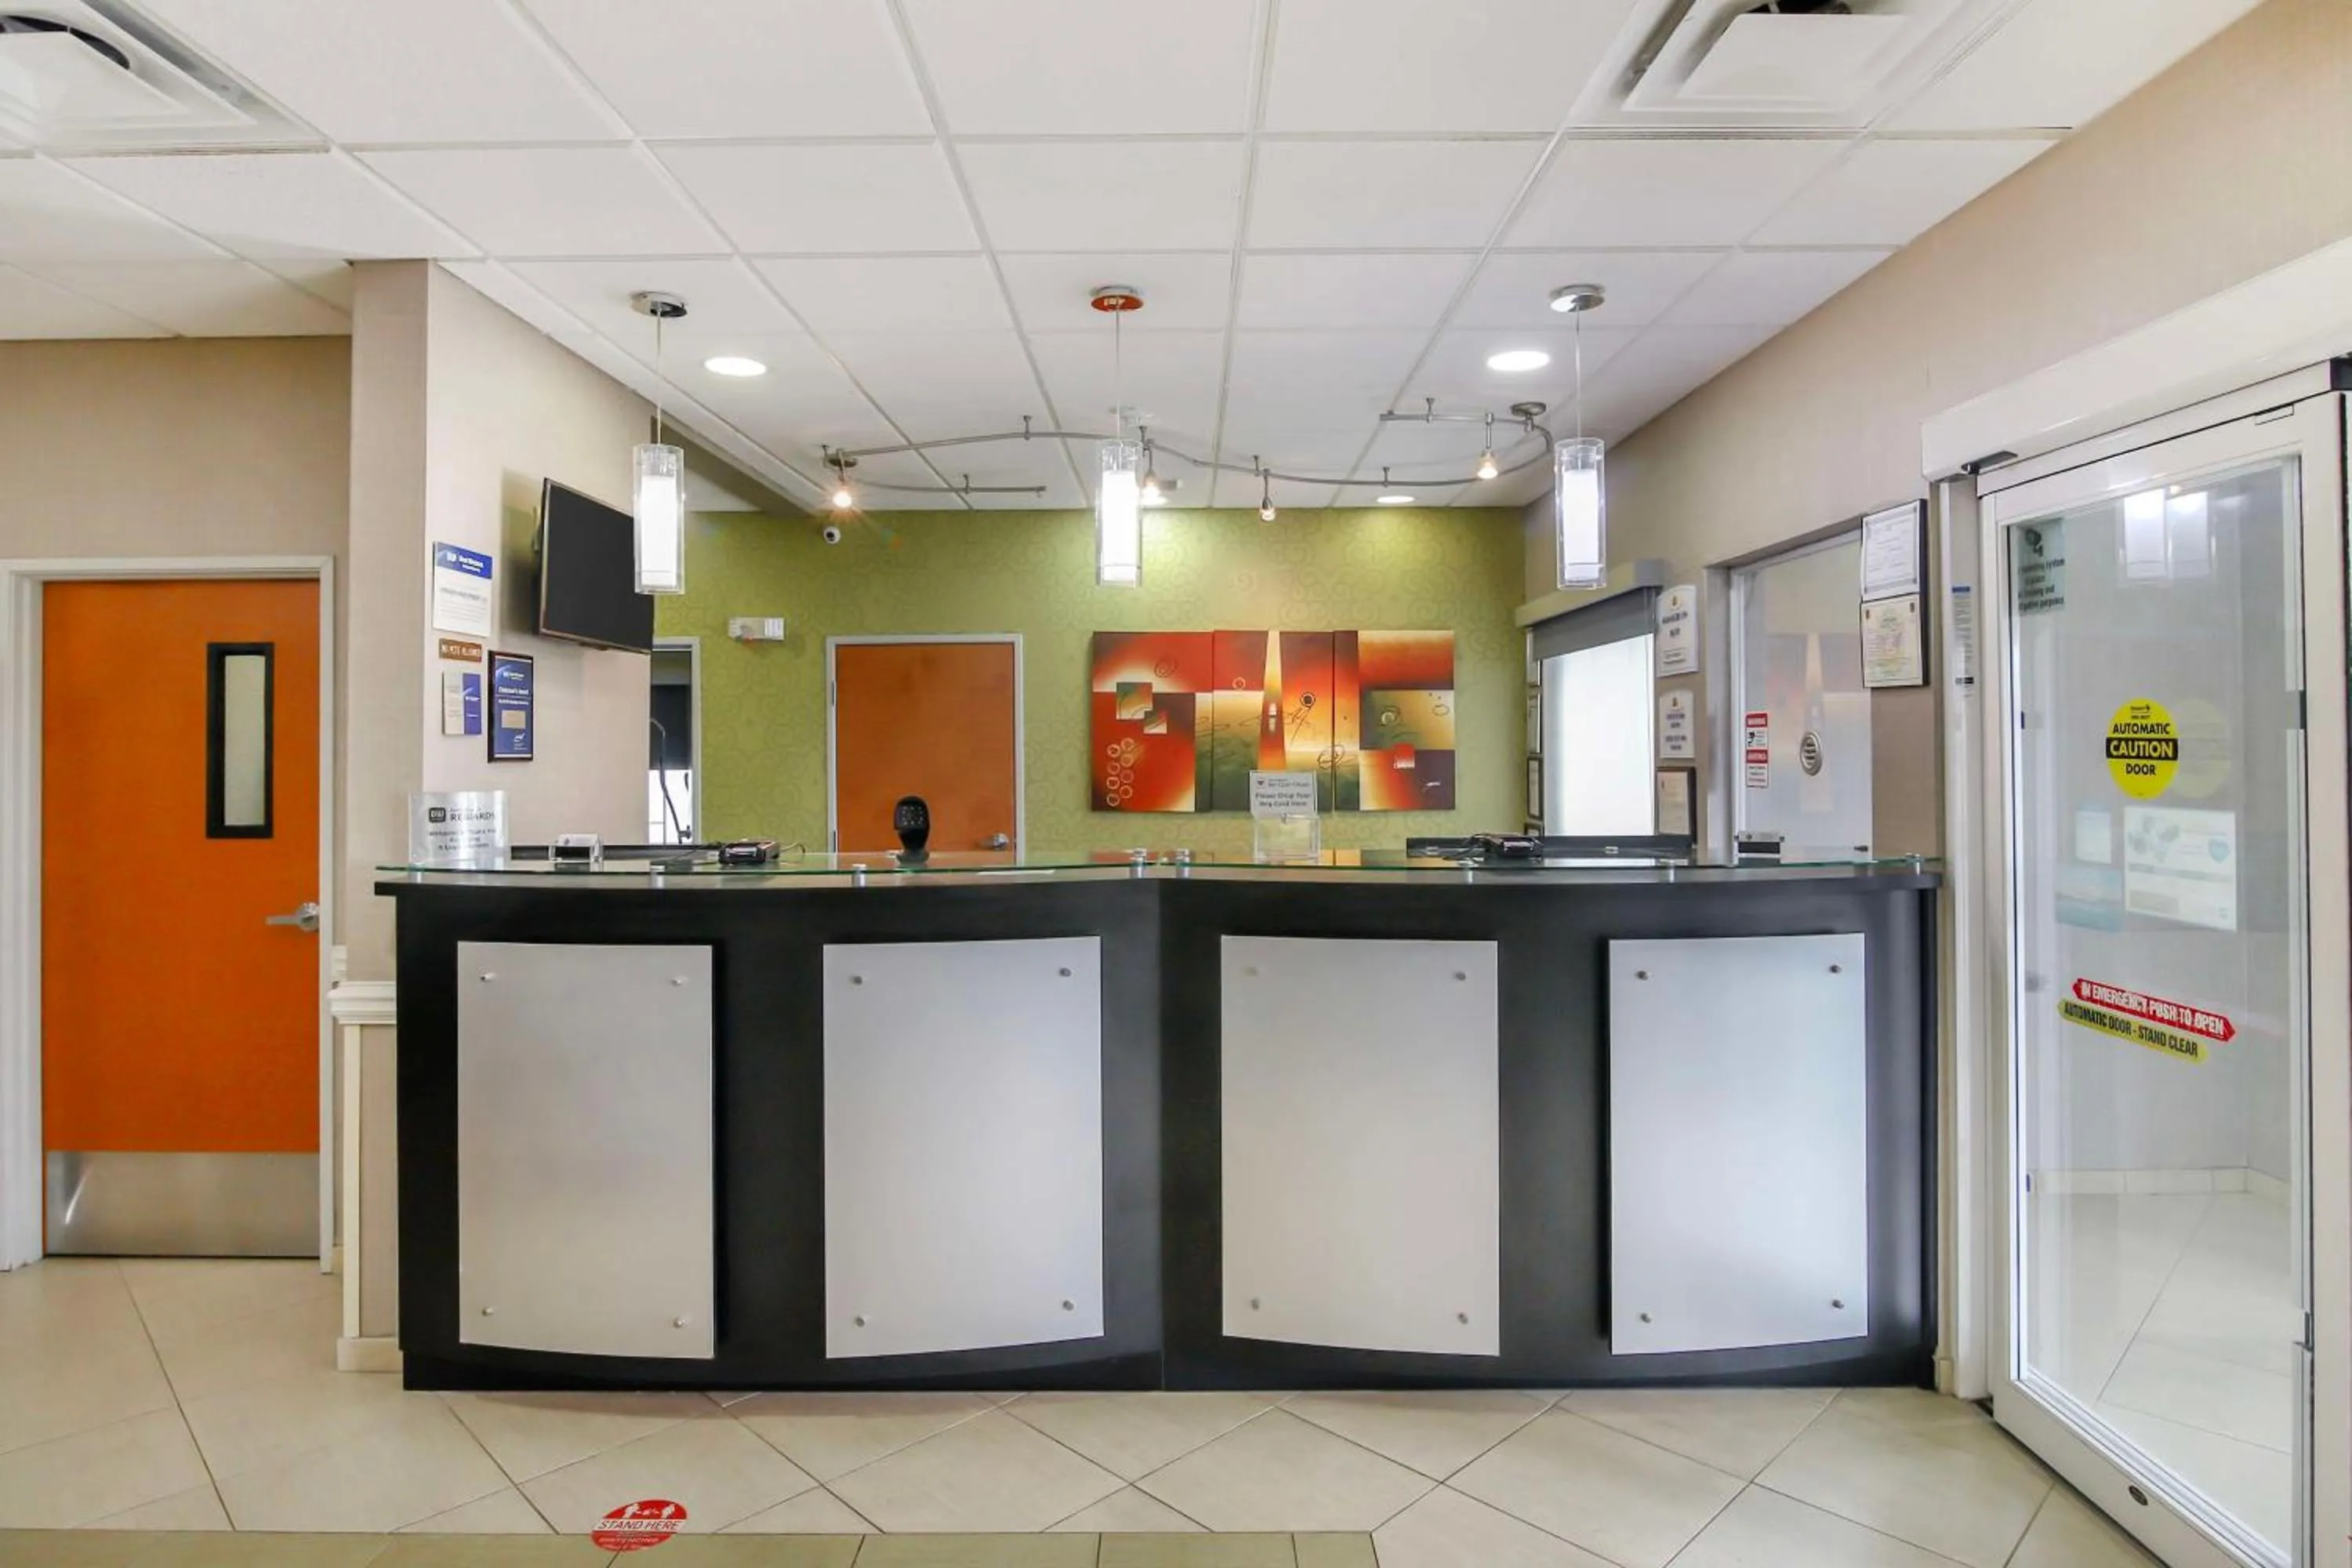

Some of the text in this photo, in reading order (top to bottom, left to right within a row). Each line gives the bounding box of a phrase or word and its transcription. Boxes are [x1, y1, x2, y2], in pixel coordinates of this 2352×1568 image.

[2113, 723, 2170, 735] AUTOMATIC
[2110, 740, 2173, 758] CAUTION
[2125, 763, 2156, 775] DOOR
[2082, 982, 2224, 1035] IN EMERGENCY PUSH TO OPEN
[2064, 1001, 2107, 1027] AUTOMATIC
[2108, 1015, 2132, 1036] DOOR
[2138, 1025, 2167, 1047] STAND
[2168, 1034, 2198, 1058] CLEAR
[598, 1520, 682, 1530] STAND HERE
